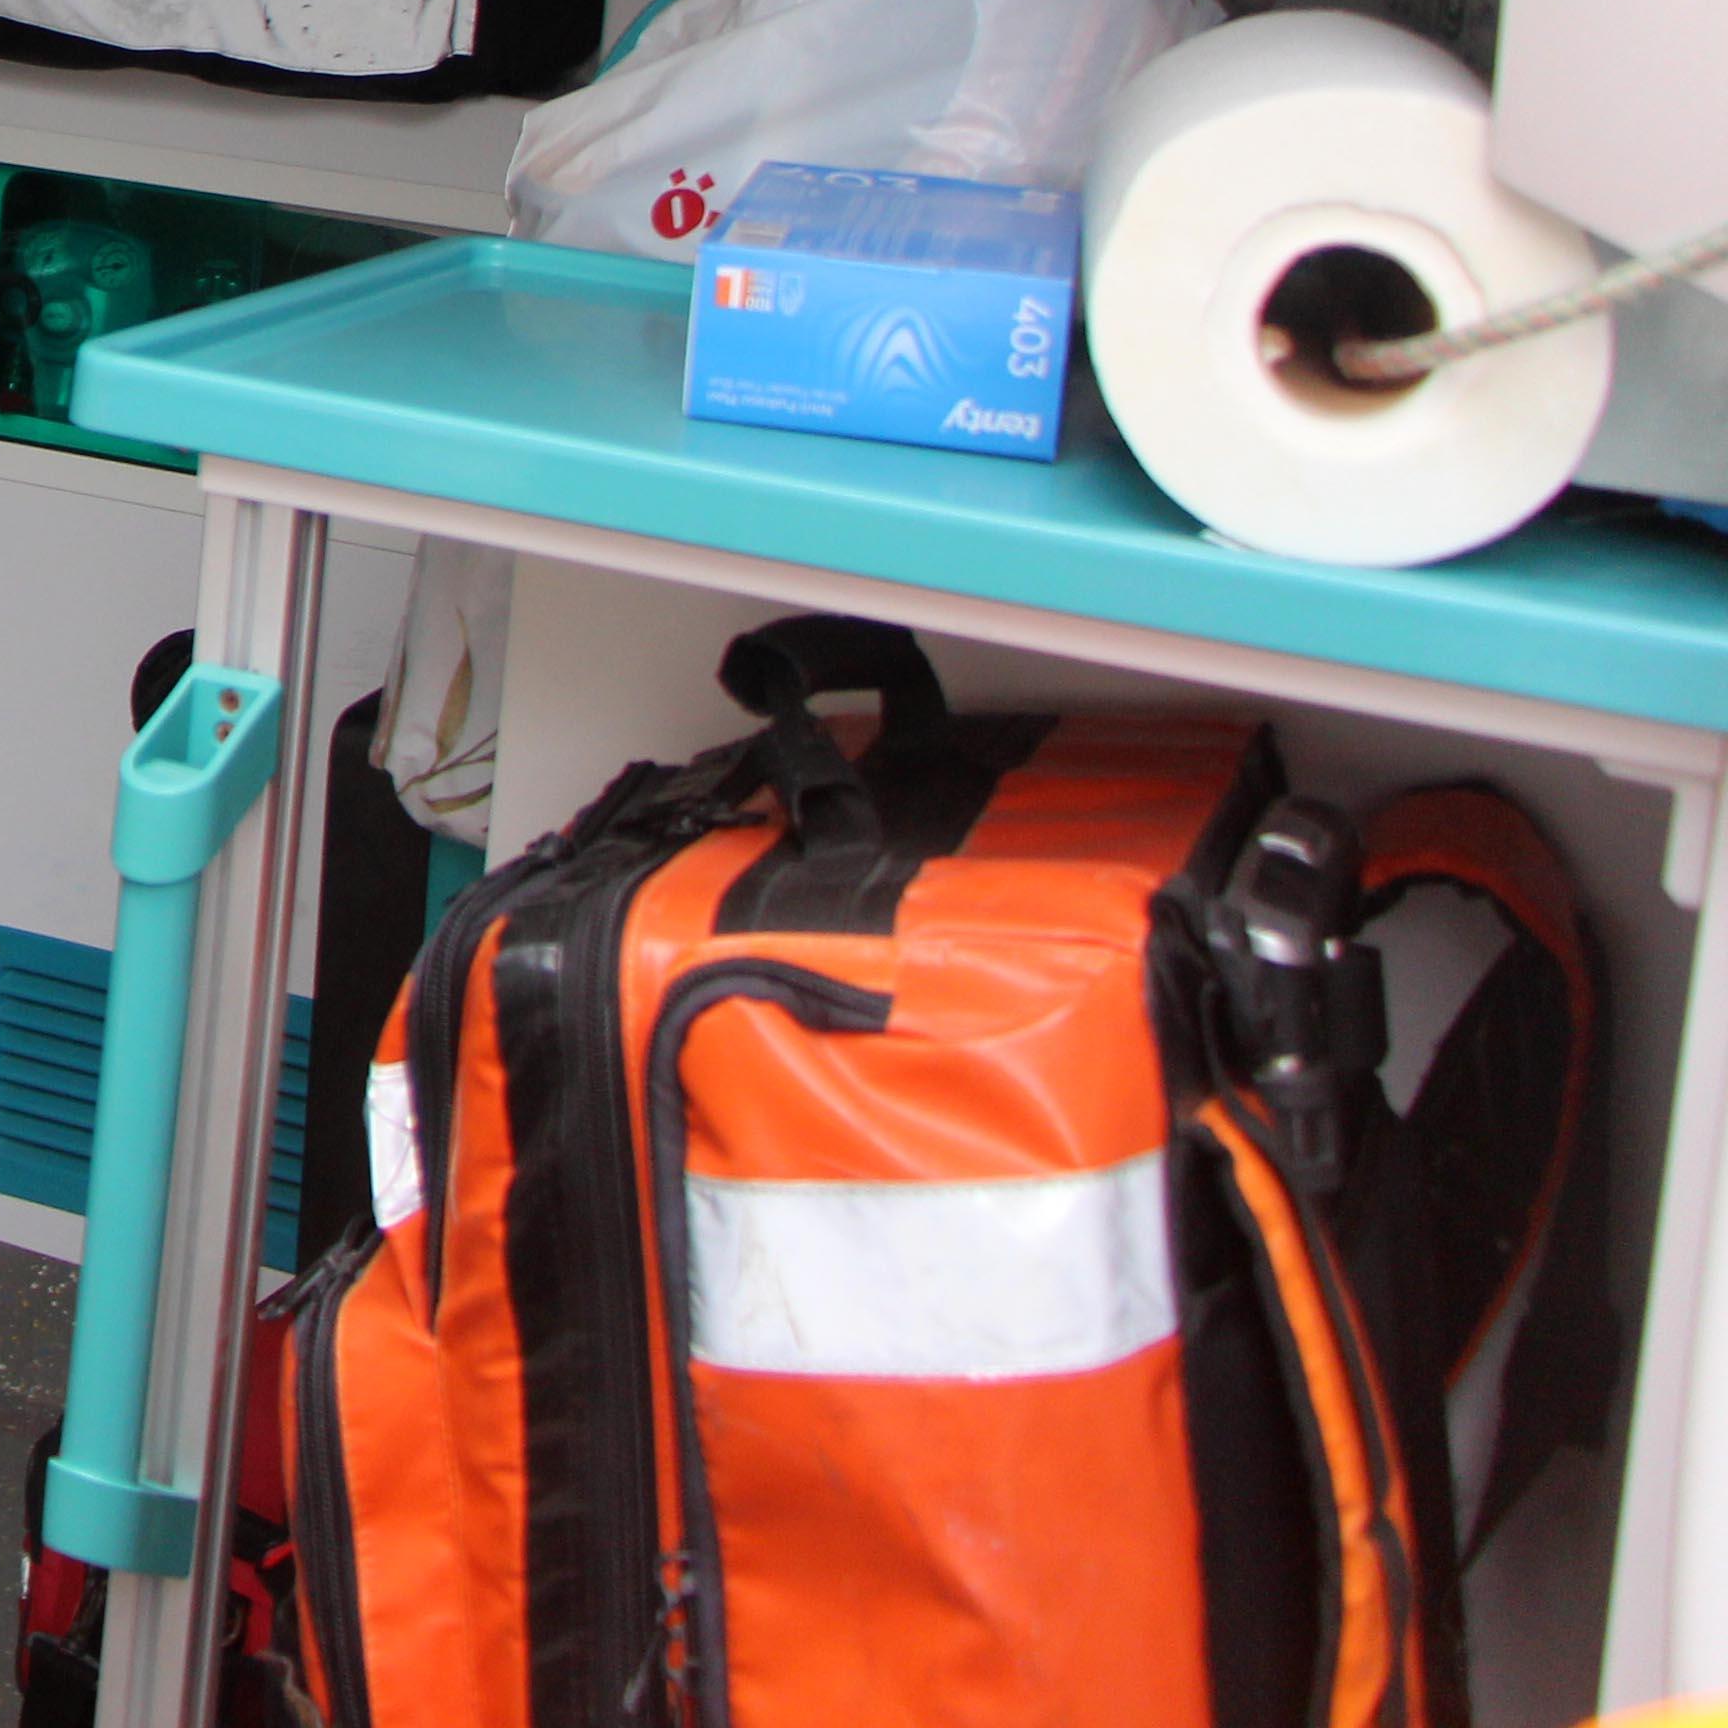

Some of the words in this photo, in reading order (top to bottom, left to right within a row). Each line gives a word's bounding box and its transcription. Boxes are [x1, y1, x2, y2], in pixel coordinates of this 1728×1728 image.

[651, 167, 721, 240] Ö
[1008, 294, 1051, 379] 403
[943, 399, 1043, 442] tenty
